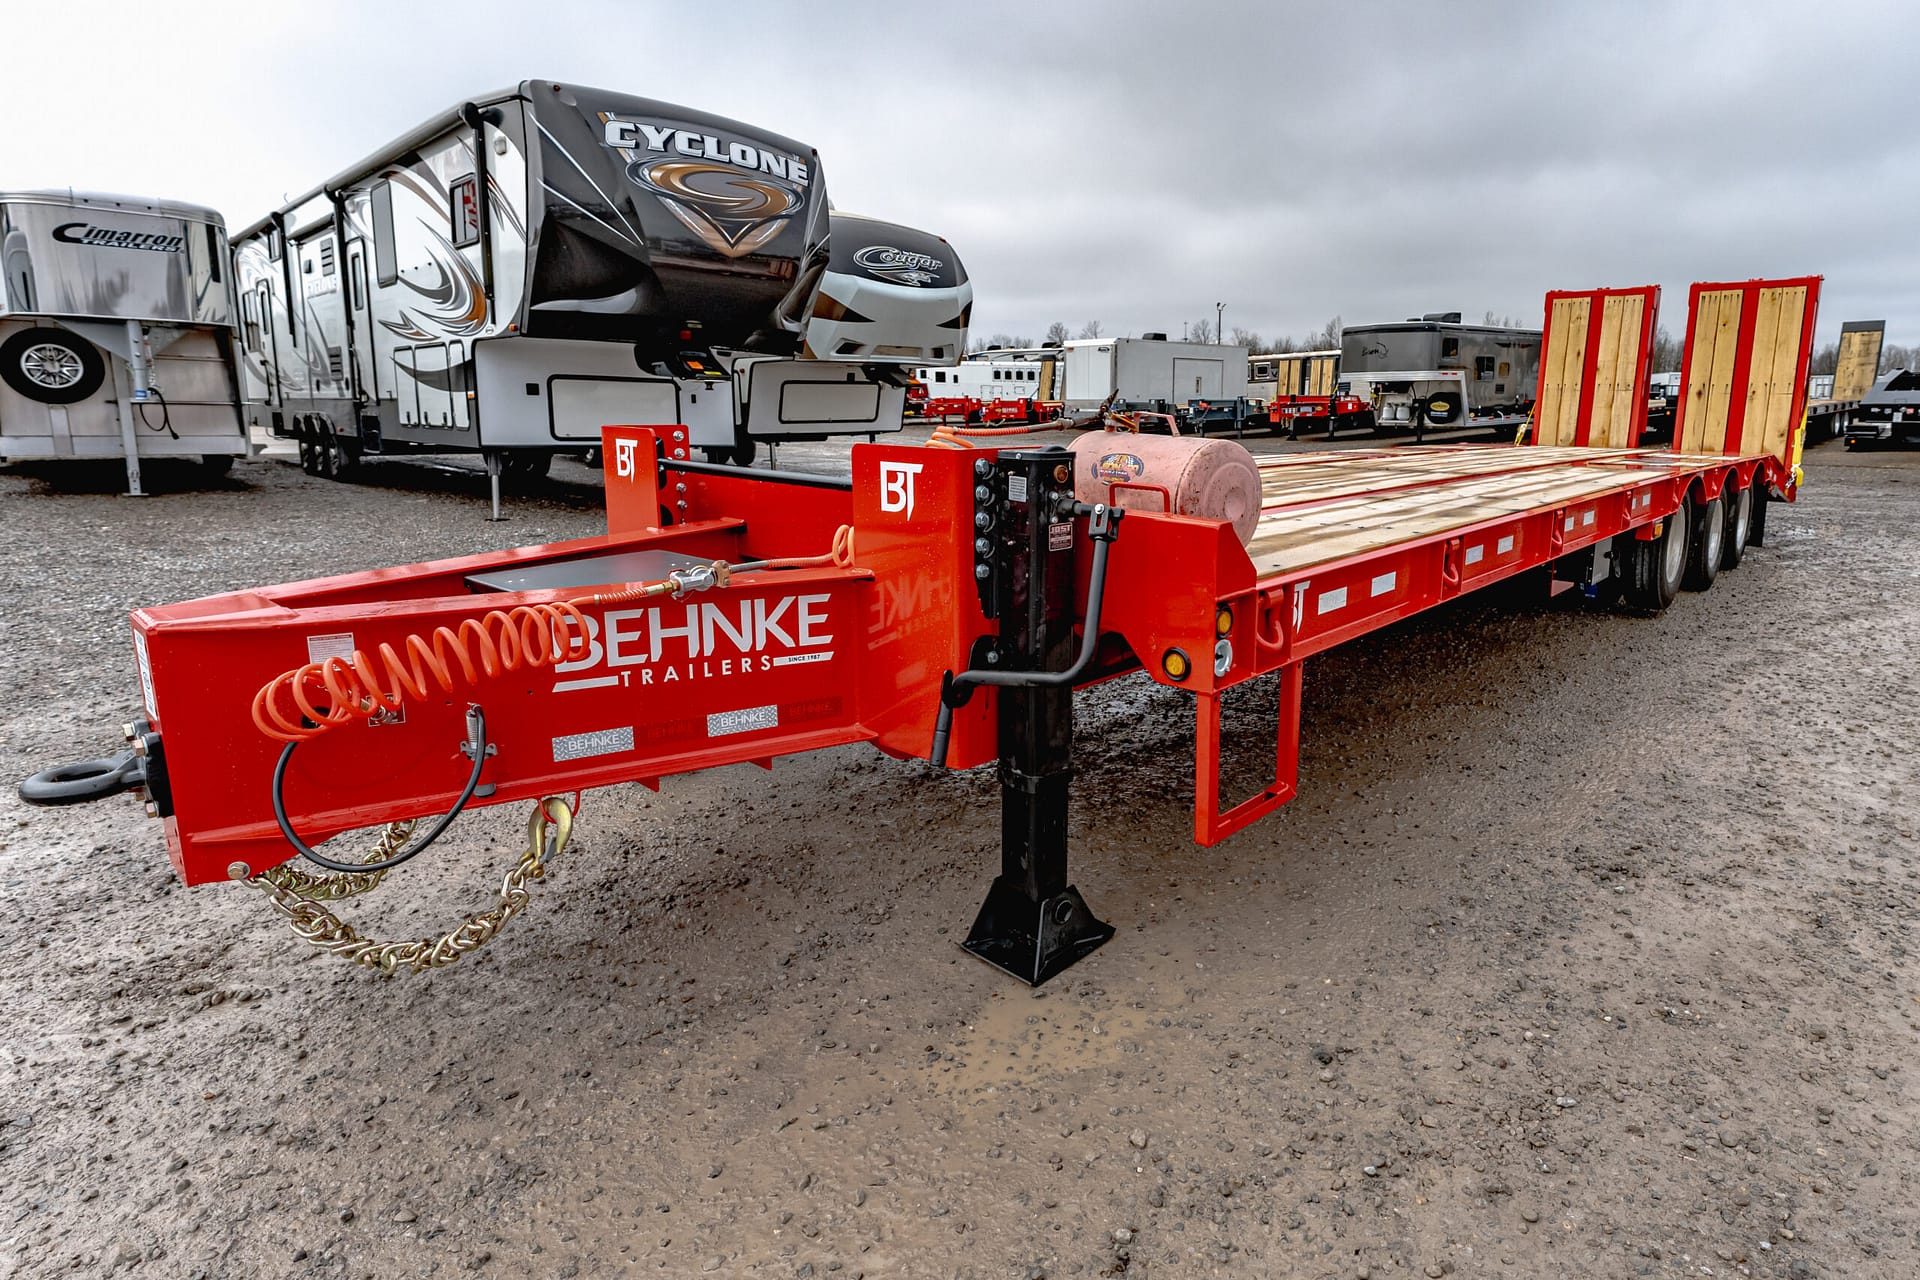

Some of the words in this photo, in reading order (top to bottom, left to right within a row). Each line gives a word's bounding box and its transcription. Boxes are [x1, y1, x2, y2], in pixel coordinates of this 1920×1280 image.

[604, 120, 809, 187] CYCLONE
[52, 222, 183, 246] Cimarron
[853, 246, 943, 271] Cougar
[615, 438, 638, 483] BT
[880, 461, 924, 522] BT
[551, 593, 834, 673] BEHNKE
[620, 655, 771, 687] TRAILERS
[721, 711, 766, 727] BEHNKE
[567, 733, 620, 751] BEHNKE
